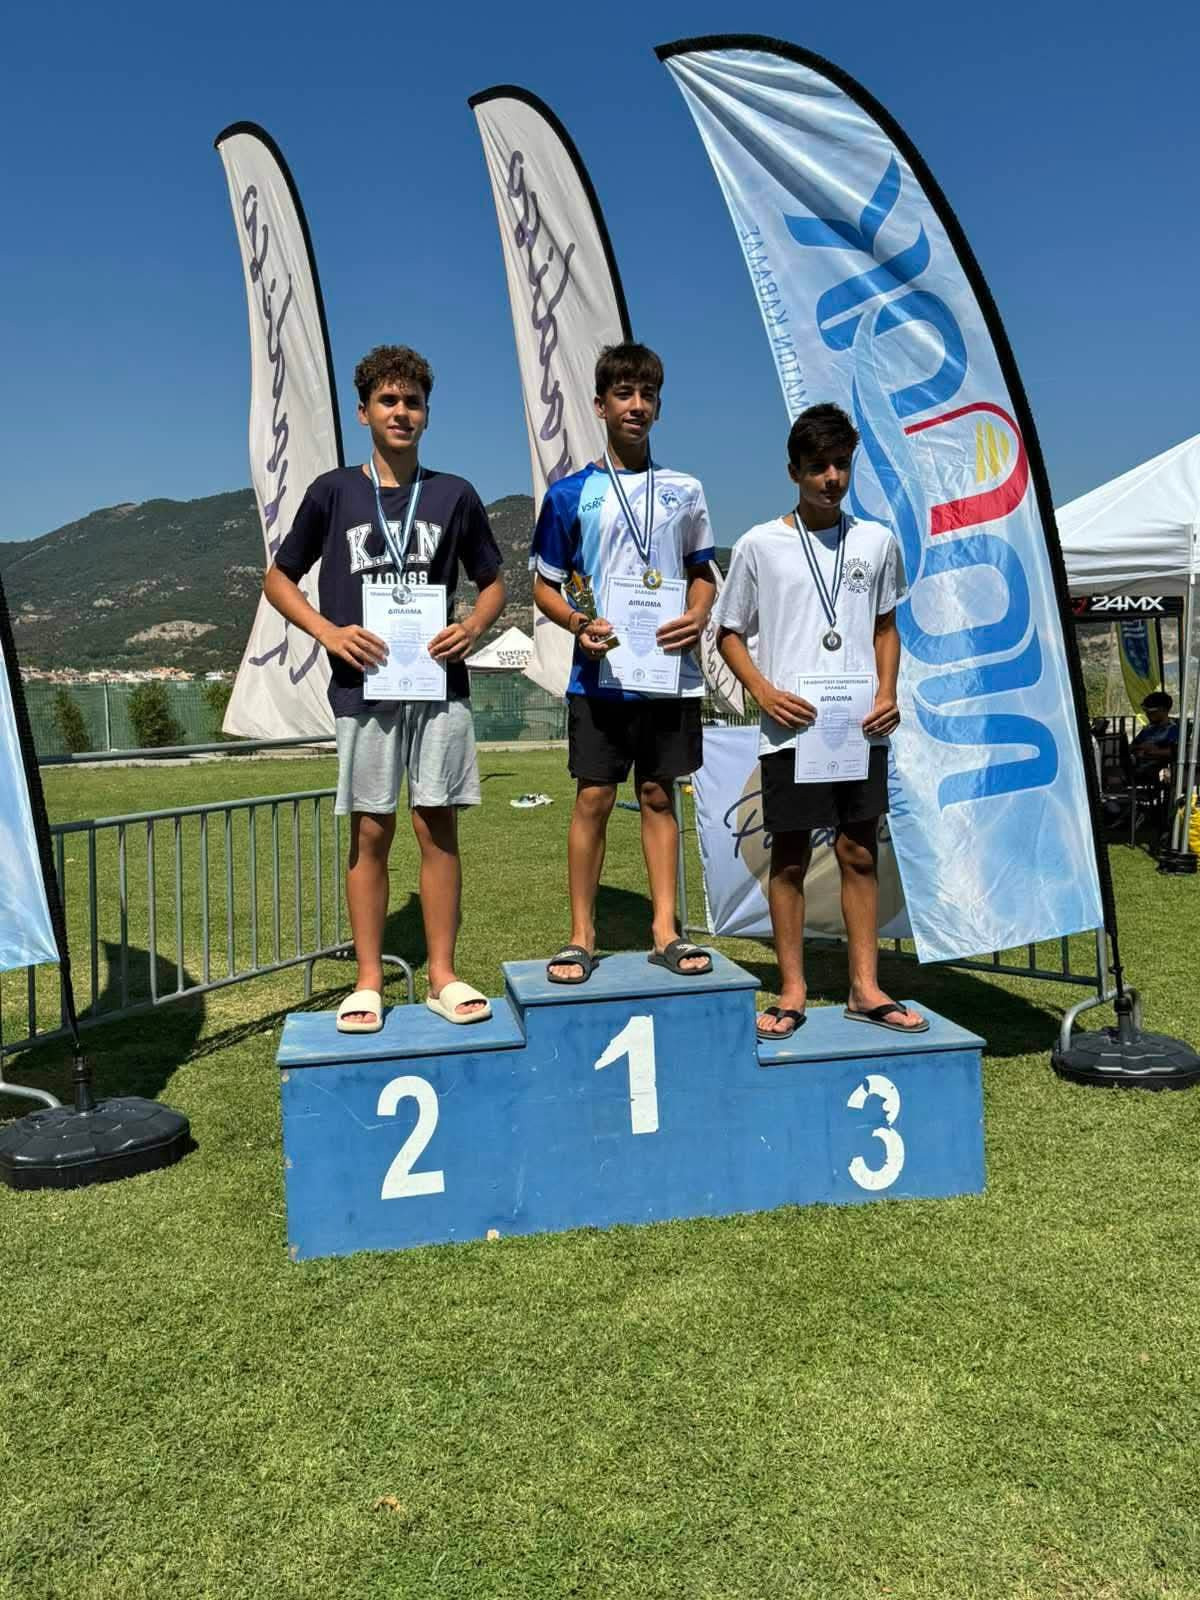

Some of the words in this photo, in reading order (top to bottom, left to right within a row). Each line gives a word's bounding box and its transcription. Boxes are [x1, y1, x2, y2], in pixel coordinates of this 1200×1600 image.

[628, 599, 661, 608] ΔΙΠΛΩΜΑ
[1090, 595, 1165, 611] 24MX
[594, 1014, 660, 1135] 1
[846, 1074, 906, 1192] 3
[376, 1075, 445, 1200] 2
